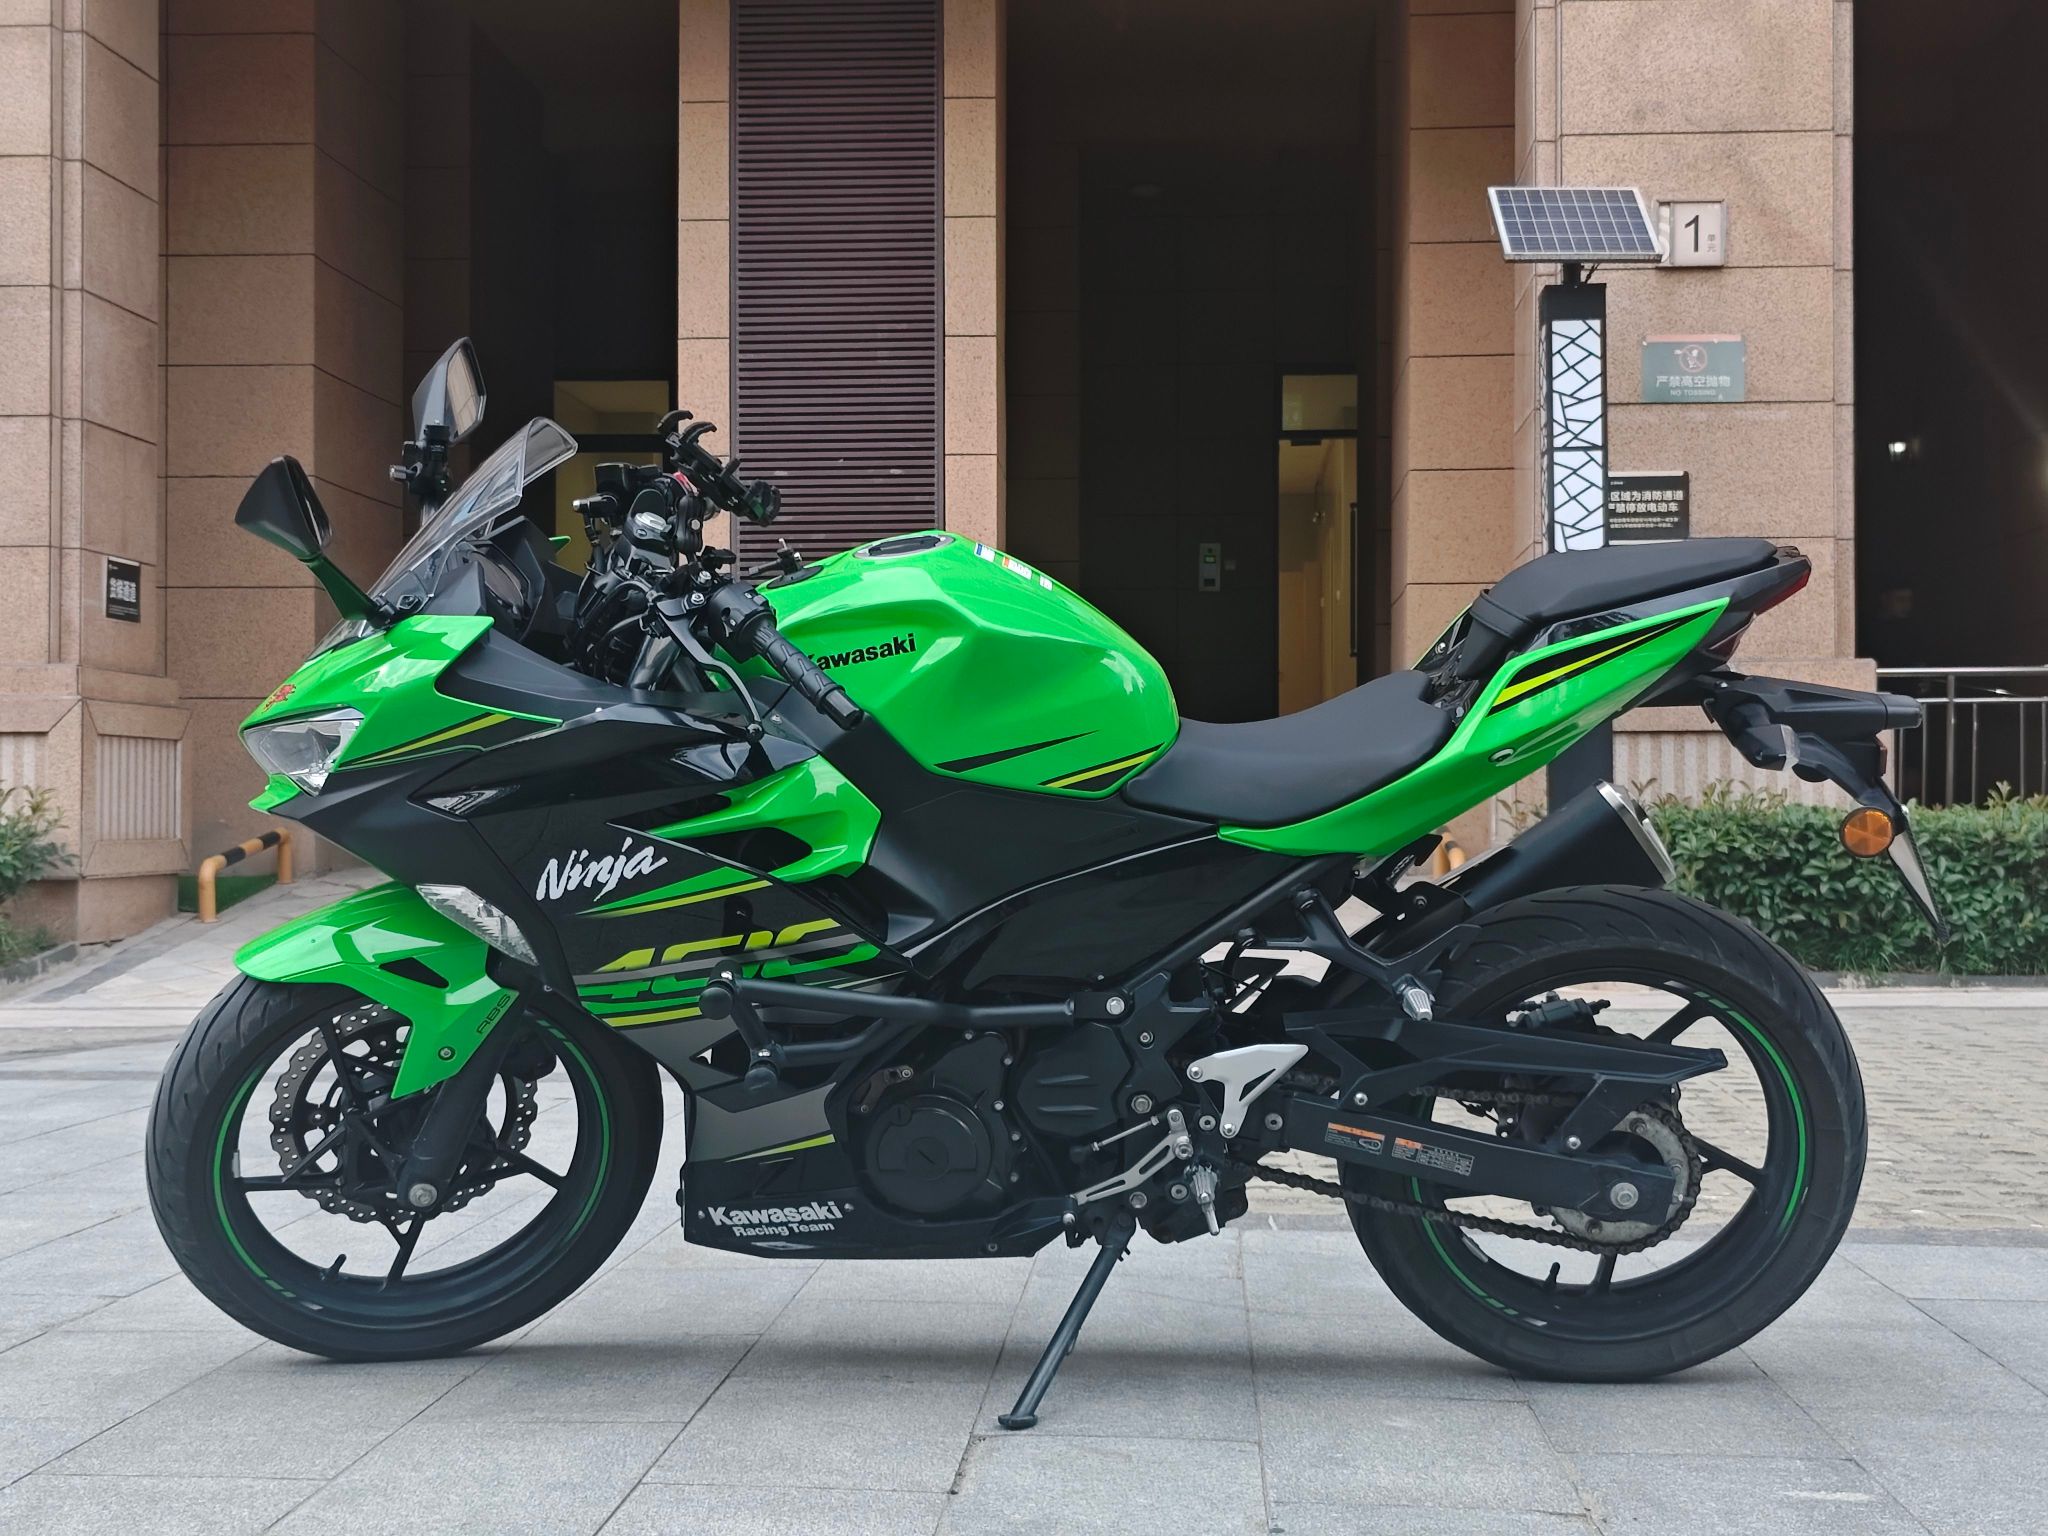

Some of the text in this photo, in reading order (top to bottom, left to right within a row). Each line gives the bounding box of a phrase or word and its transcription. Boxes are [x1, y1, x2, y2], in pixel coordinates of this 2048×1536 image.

[1684, 214, 1700, 253] 1
[1656, 375, 1731, 388] 严禁高空抛物
[1608, 490, 1684, 502] 区域为消防通道
[807, 633, 916, 671] awasaki
[536, 836, 668, 902] Ninja
[477, 994, 511, 1034] ABS
[707, 1201, 844, 1226] Kawasaki
[732, 1222, 835, 1237] Racing Team
